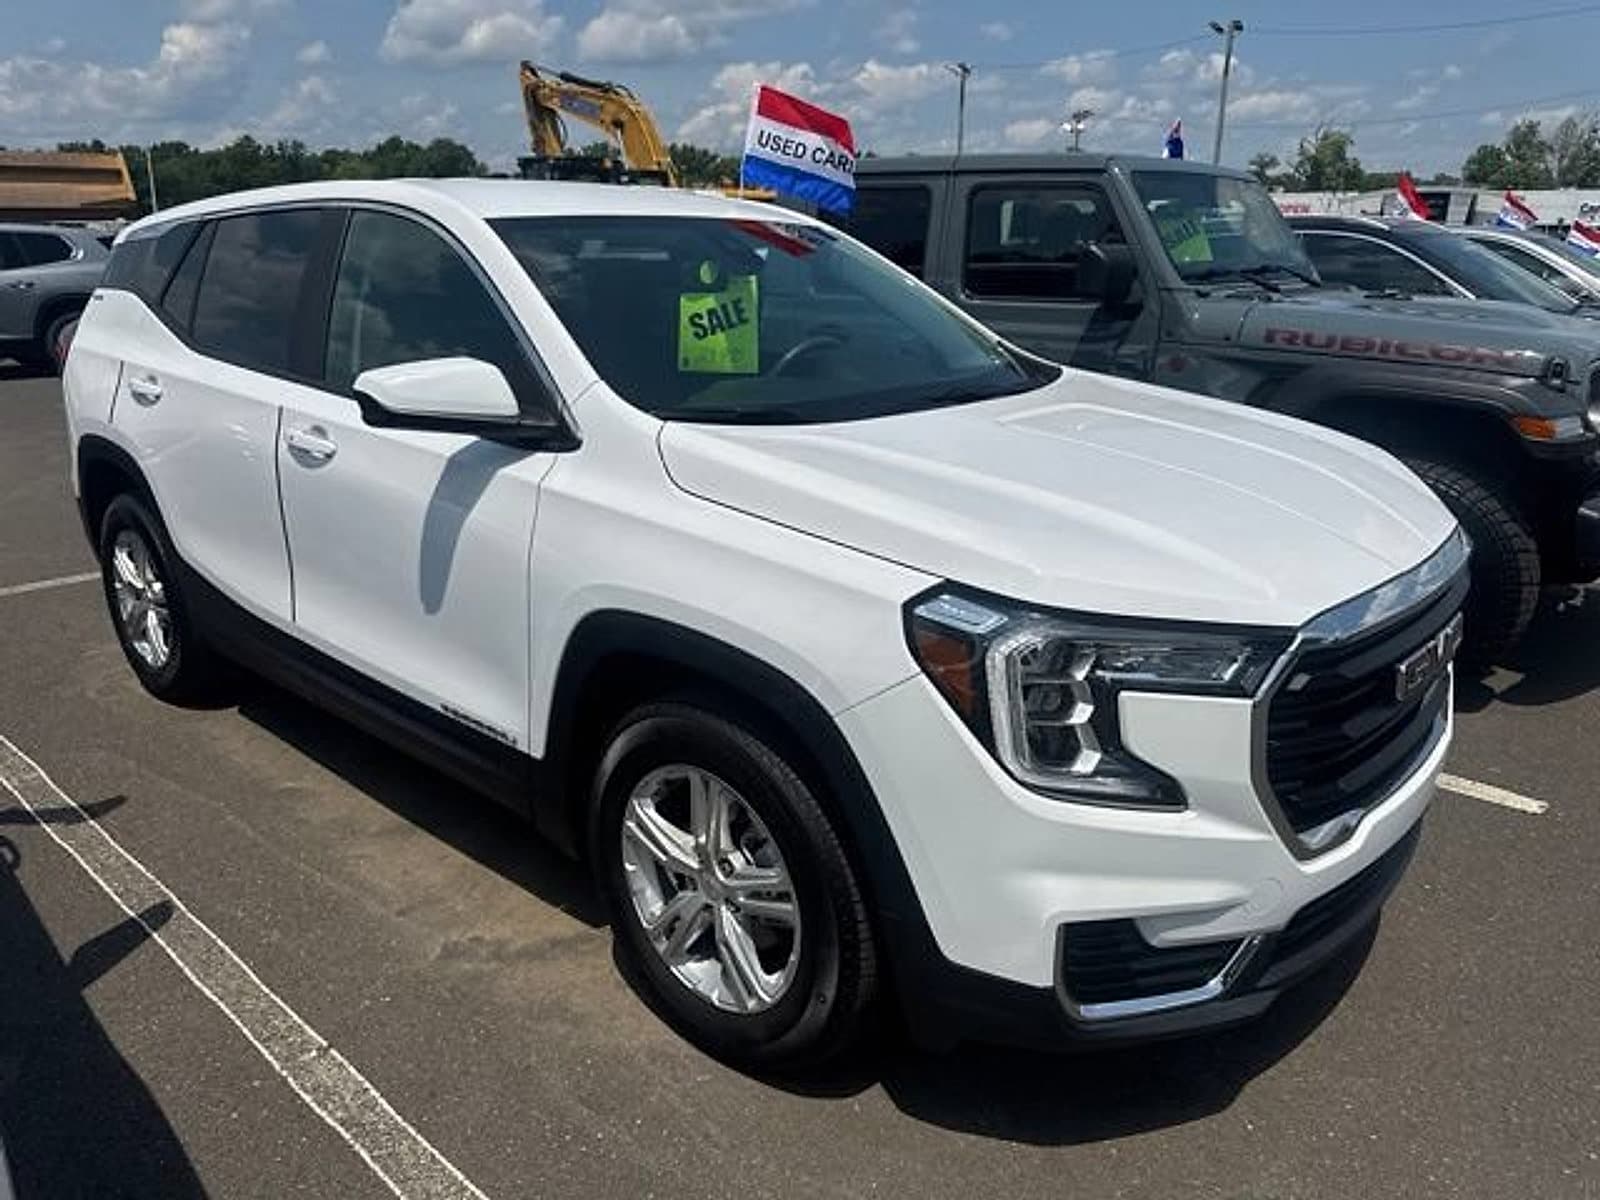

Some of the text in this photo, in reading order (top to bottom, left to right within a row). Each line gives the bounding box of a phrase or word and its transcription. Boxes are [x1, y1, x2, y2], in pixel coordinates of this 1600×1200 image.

[757, 129, 807, 159] USED
[689, 297, 749, 341] SALE
[1264, 327, 1522, 367] RUBICON
